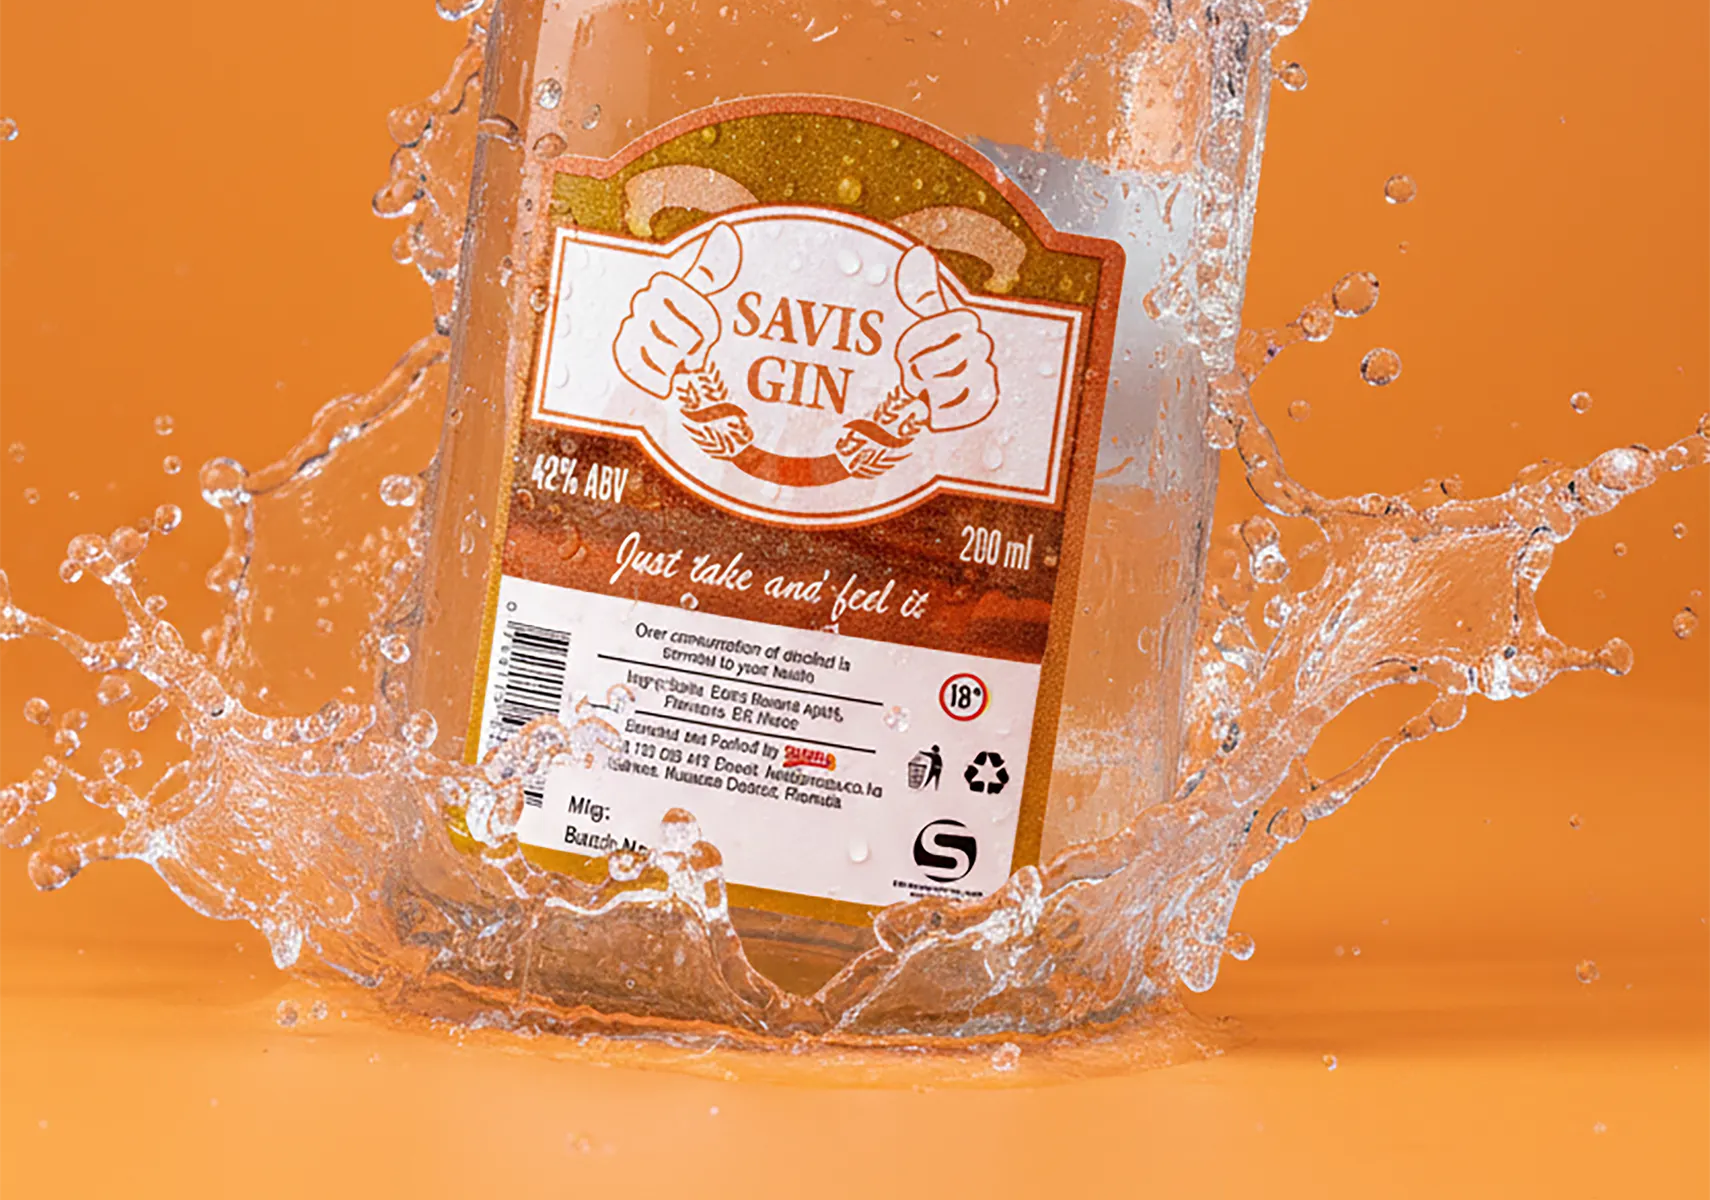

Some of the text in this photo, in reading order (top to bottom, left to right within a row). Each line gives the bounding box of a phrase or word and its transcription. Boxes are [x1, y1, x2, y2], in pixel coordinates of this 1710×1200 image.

[733, 291, 885, 356] SAVIS
[747, 356, 855, 415] GIN
[531, 453, 630, 504] 42% ABV
[613, 531, 683, 584] Just
[689, 550, 752, 592] take
[764, 568, 831, 604] and
[831, 574, 897, 622] feel
[959, 525, 1033, 570] 200 ml
